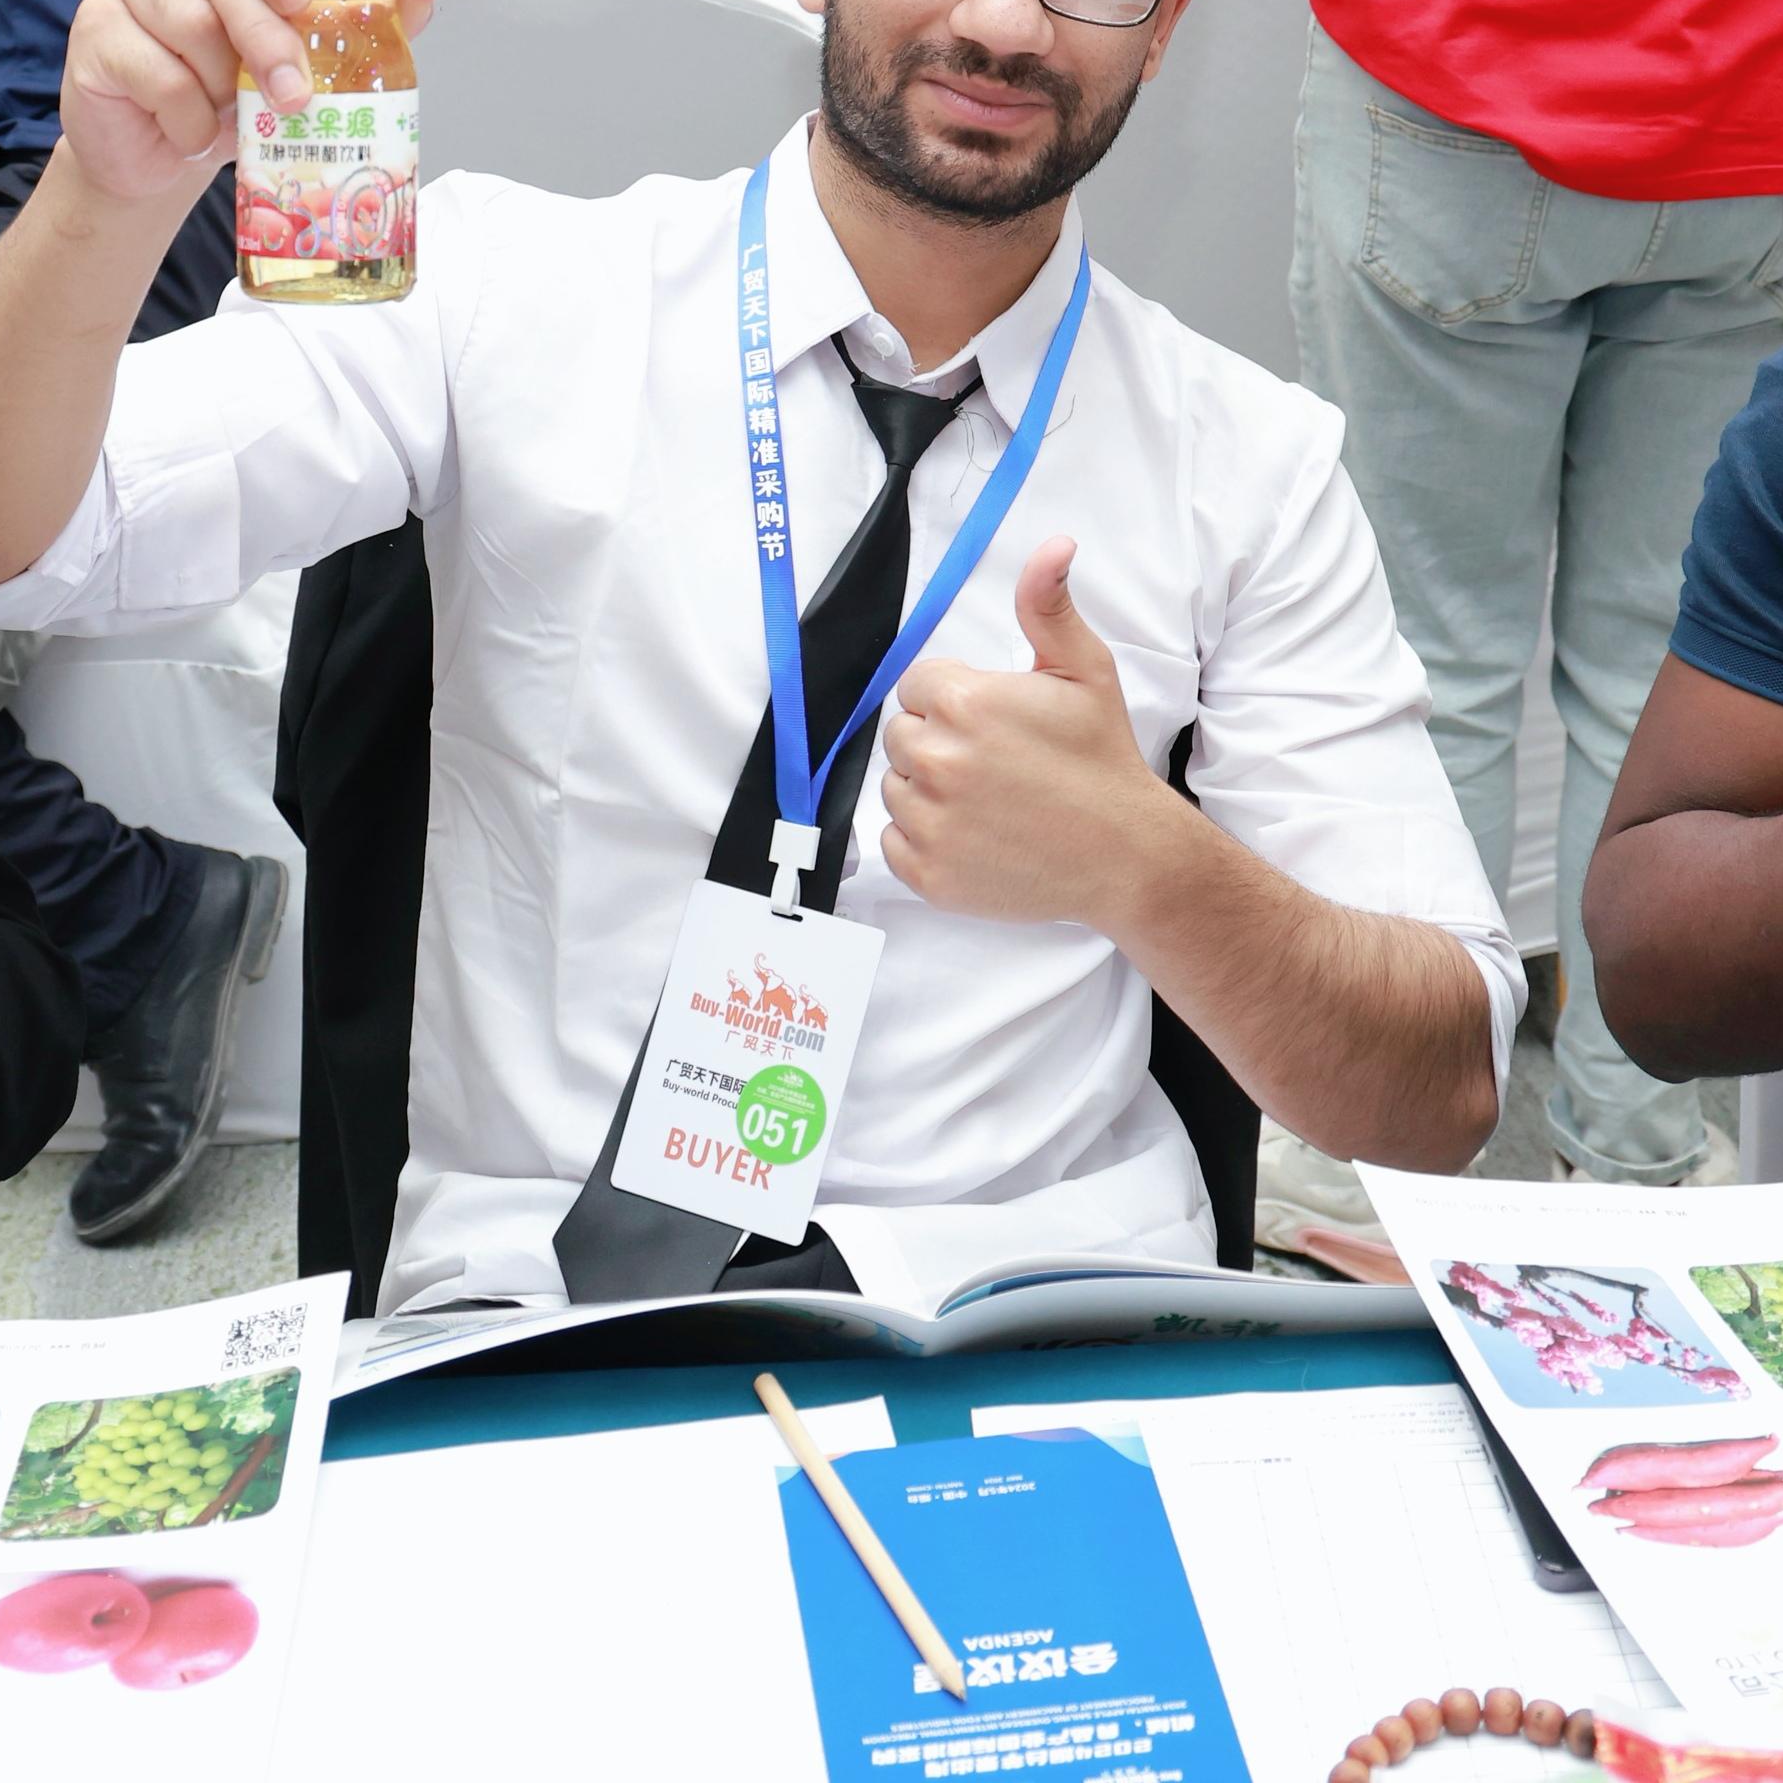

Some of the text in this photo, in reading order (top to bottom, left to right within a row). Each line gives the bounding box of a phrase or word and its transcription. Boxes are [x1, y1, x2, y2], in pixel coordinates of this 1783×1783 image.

[739, 242, 787, 562] 广贸天下国际精准采购节
[690, 991, 827, 1054] Buy-World.com
[724, 1030, 795, 1061] 广贸天下
[662, 1077, 710, 1103] Buy-world
[711, 1091, 739, 1110] Procu
[665, 1058, 749, 1096] 广贸天下国际
[741, 1102, 809, 1156] 051
[663, 1126, 775, 1191] BUYER
[962, 1628, 1055, 1652] AGENDA
